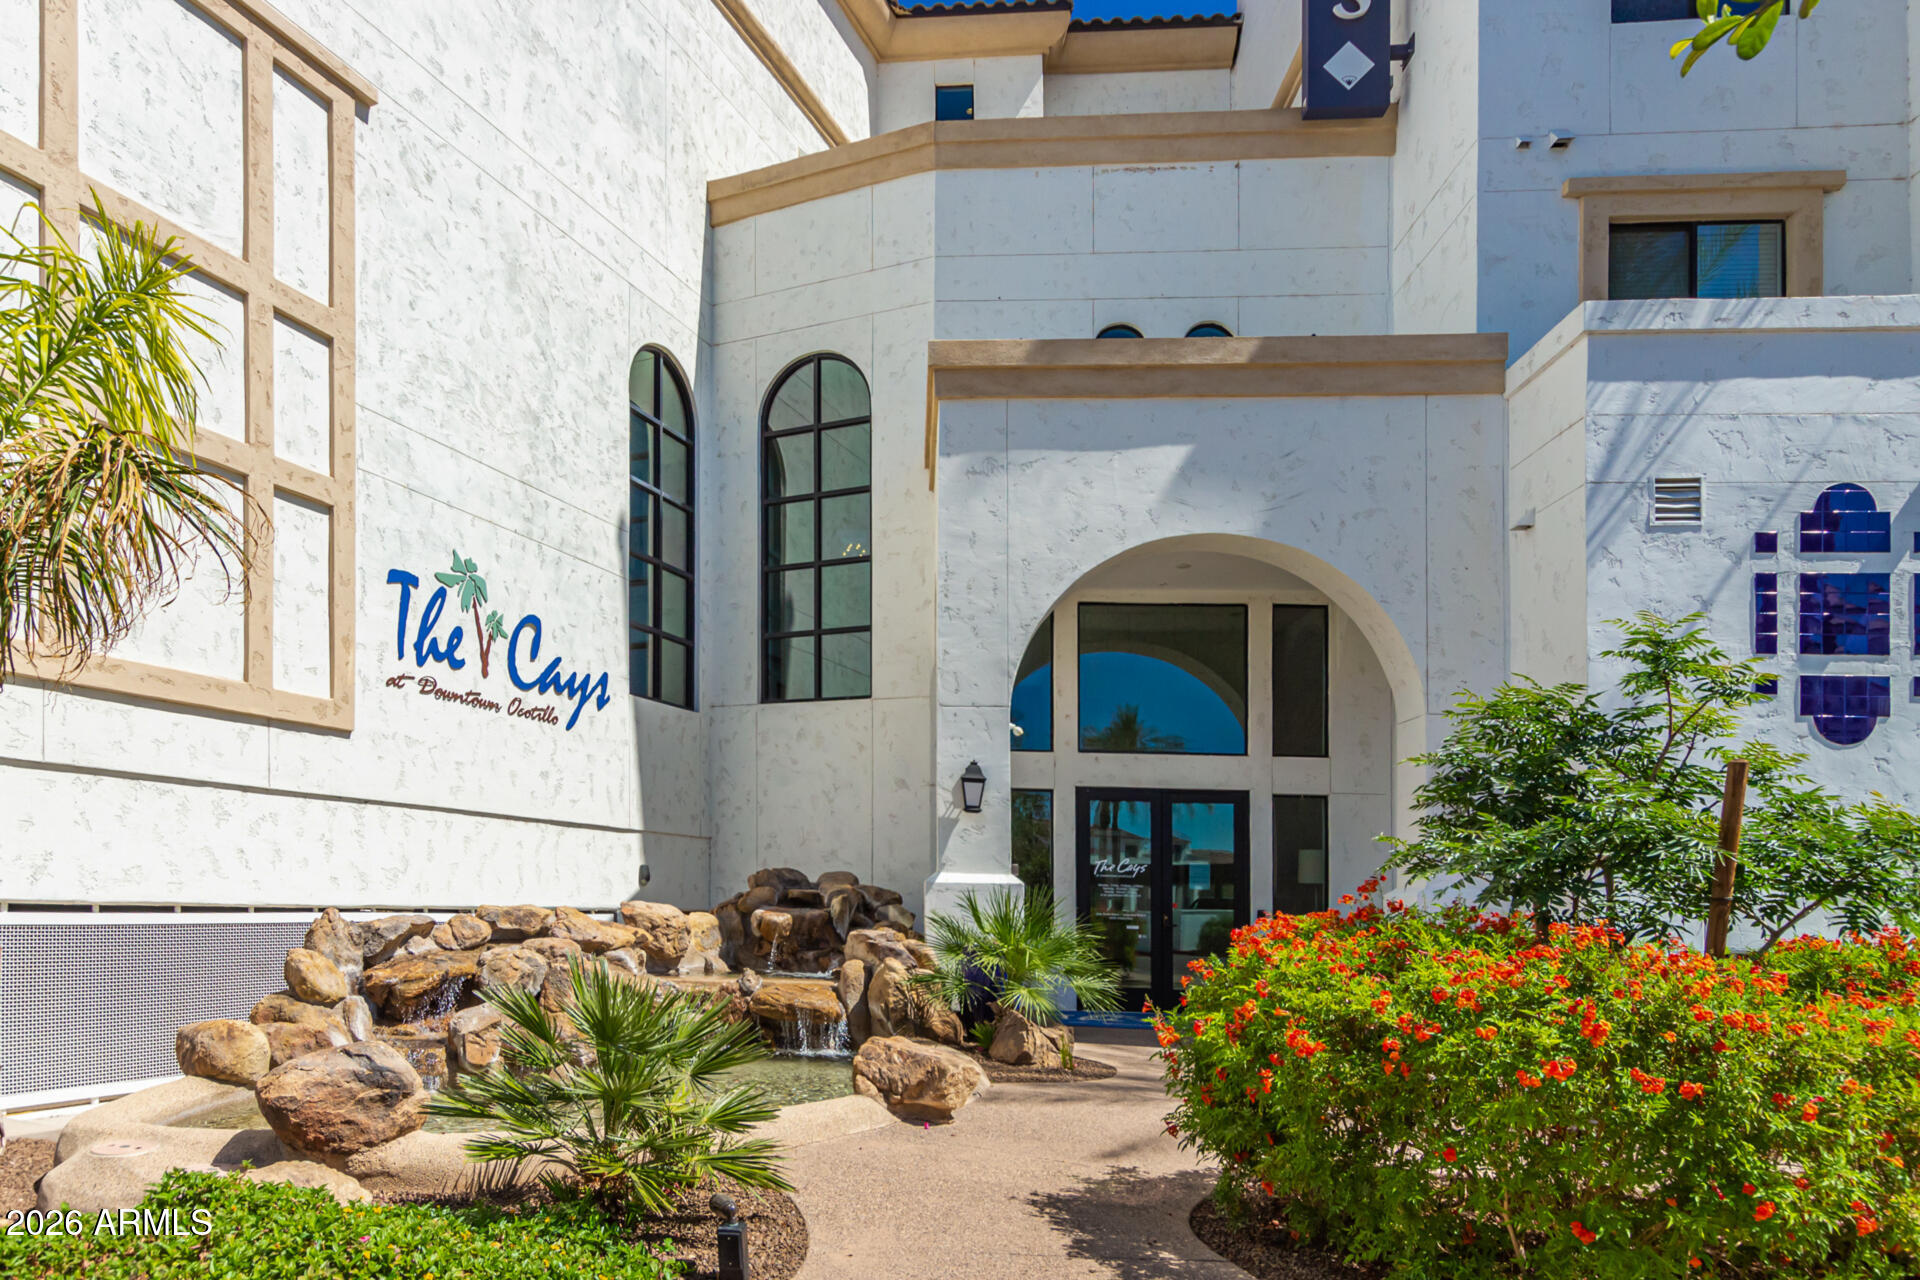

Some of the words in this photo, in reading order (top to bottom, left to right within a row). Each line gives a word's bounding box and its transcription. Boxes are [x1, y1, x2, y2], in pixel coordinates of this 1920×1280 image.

[386, 568, 466, 671] The
[507, 614, 611, 731] Cays
[385, 674, 415, 688] at
[417, 676, 502, 713] Downtown
[507, 697, 559, 726] Ocotillo
[1094, 859, 1115, 875] The
[1117, 858, 1147, 878] Cays
